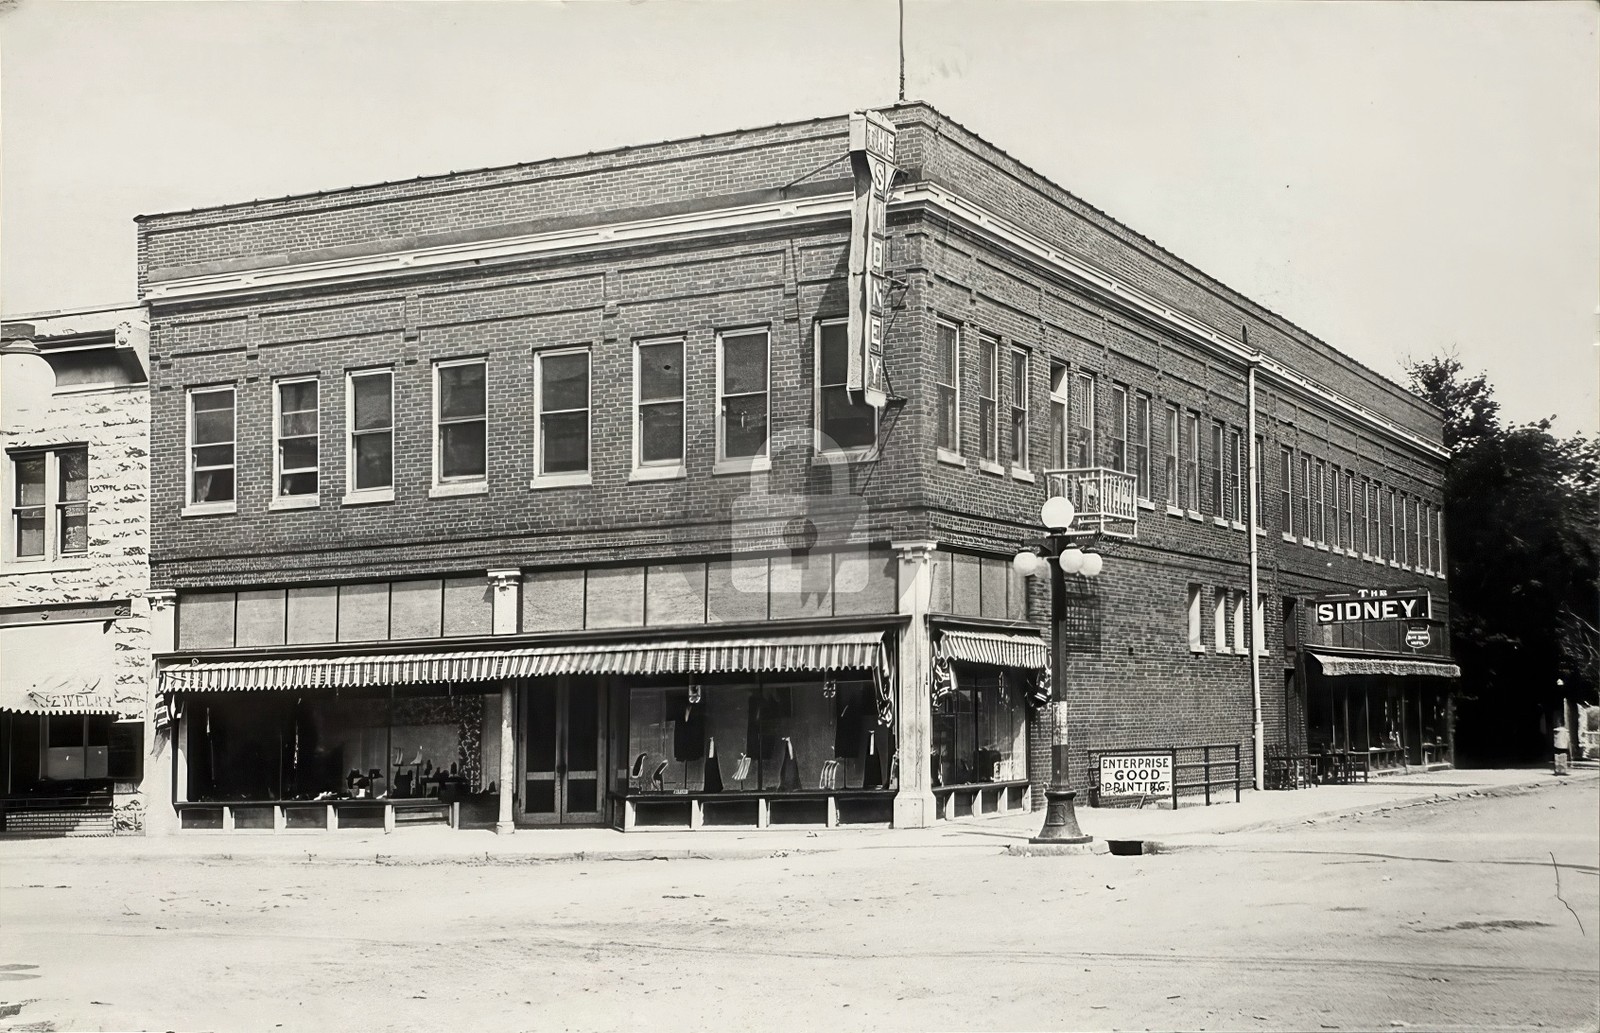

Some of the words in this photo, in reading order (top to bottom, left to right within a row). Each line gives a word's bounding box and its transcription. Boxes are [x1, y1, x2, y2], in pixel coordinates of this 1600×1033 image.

[867, 122, 895, 160] THE
[869, 161, 885, 385] SIDNEY
[1357, 589, 1388, 598] THE
[1102, 758, 1169, 769] ENTERPRISE
[1114, 769, 1160, 781] GOOD
